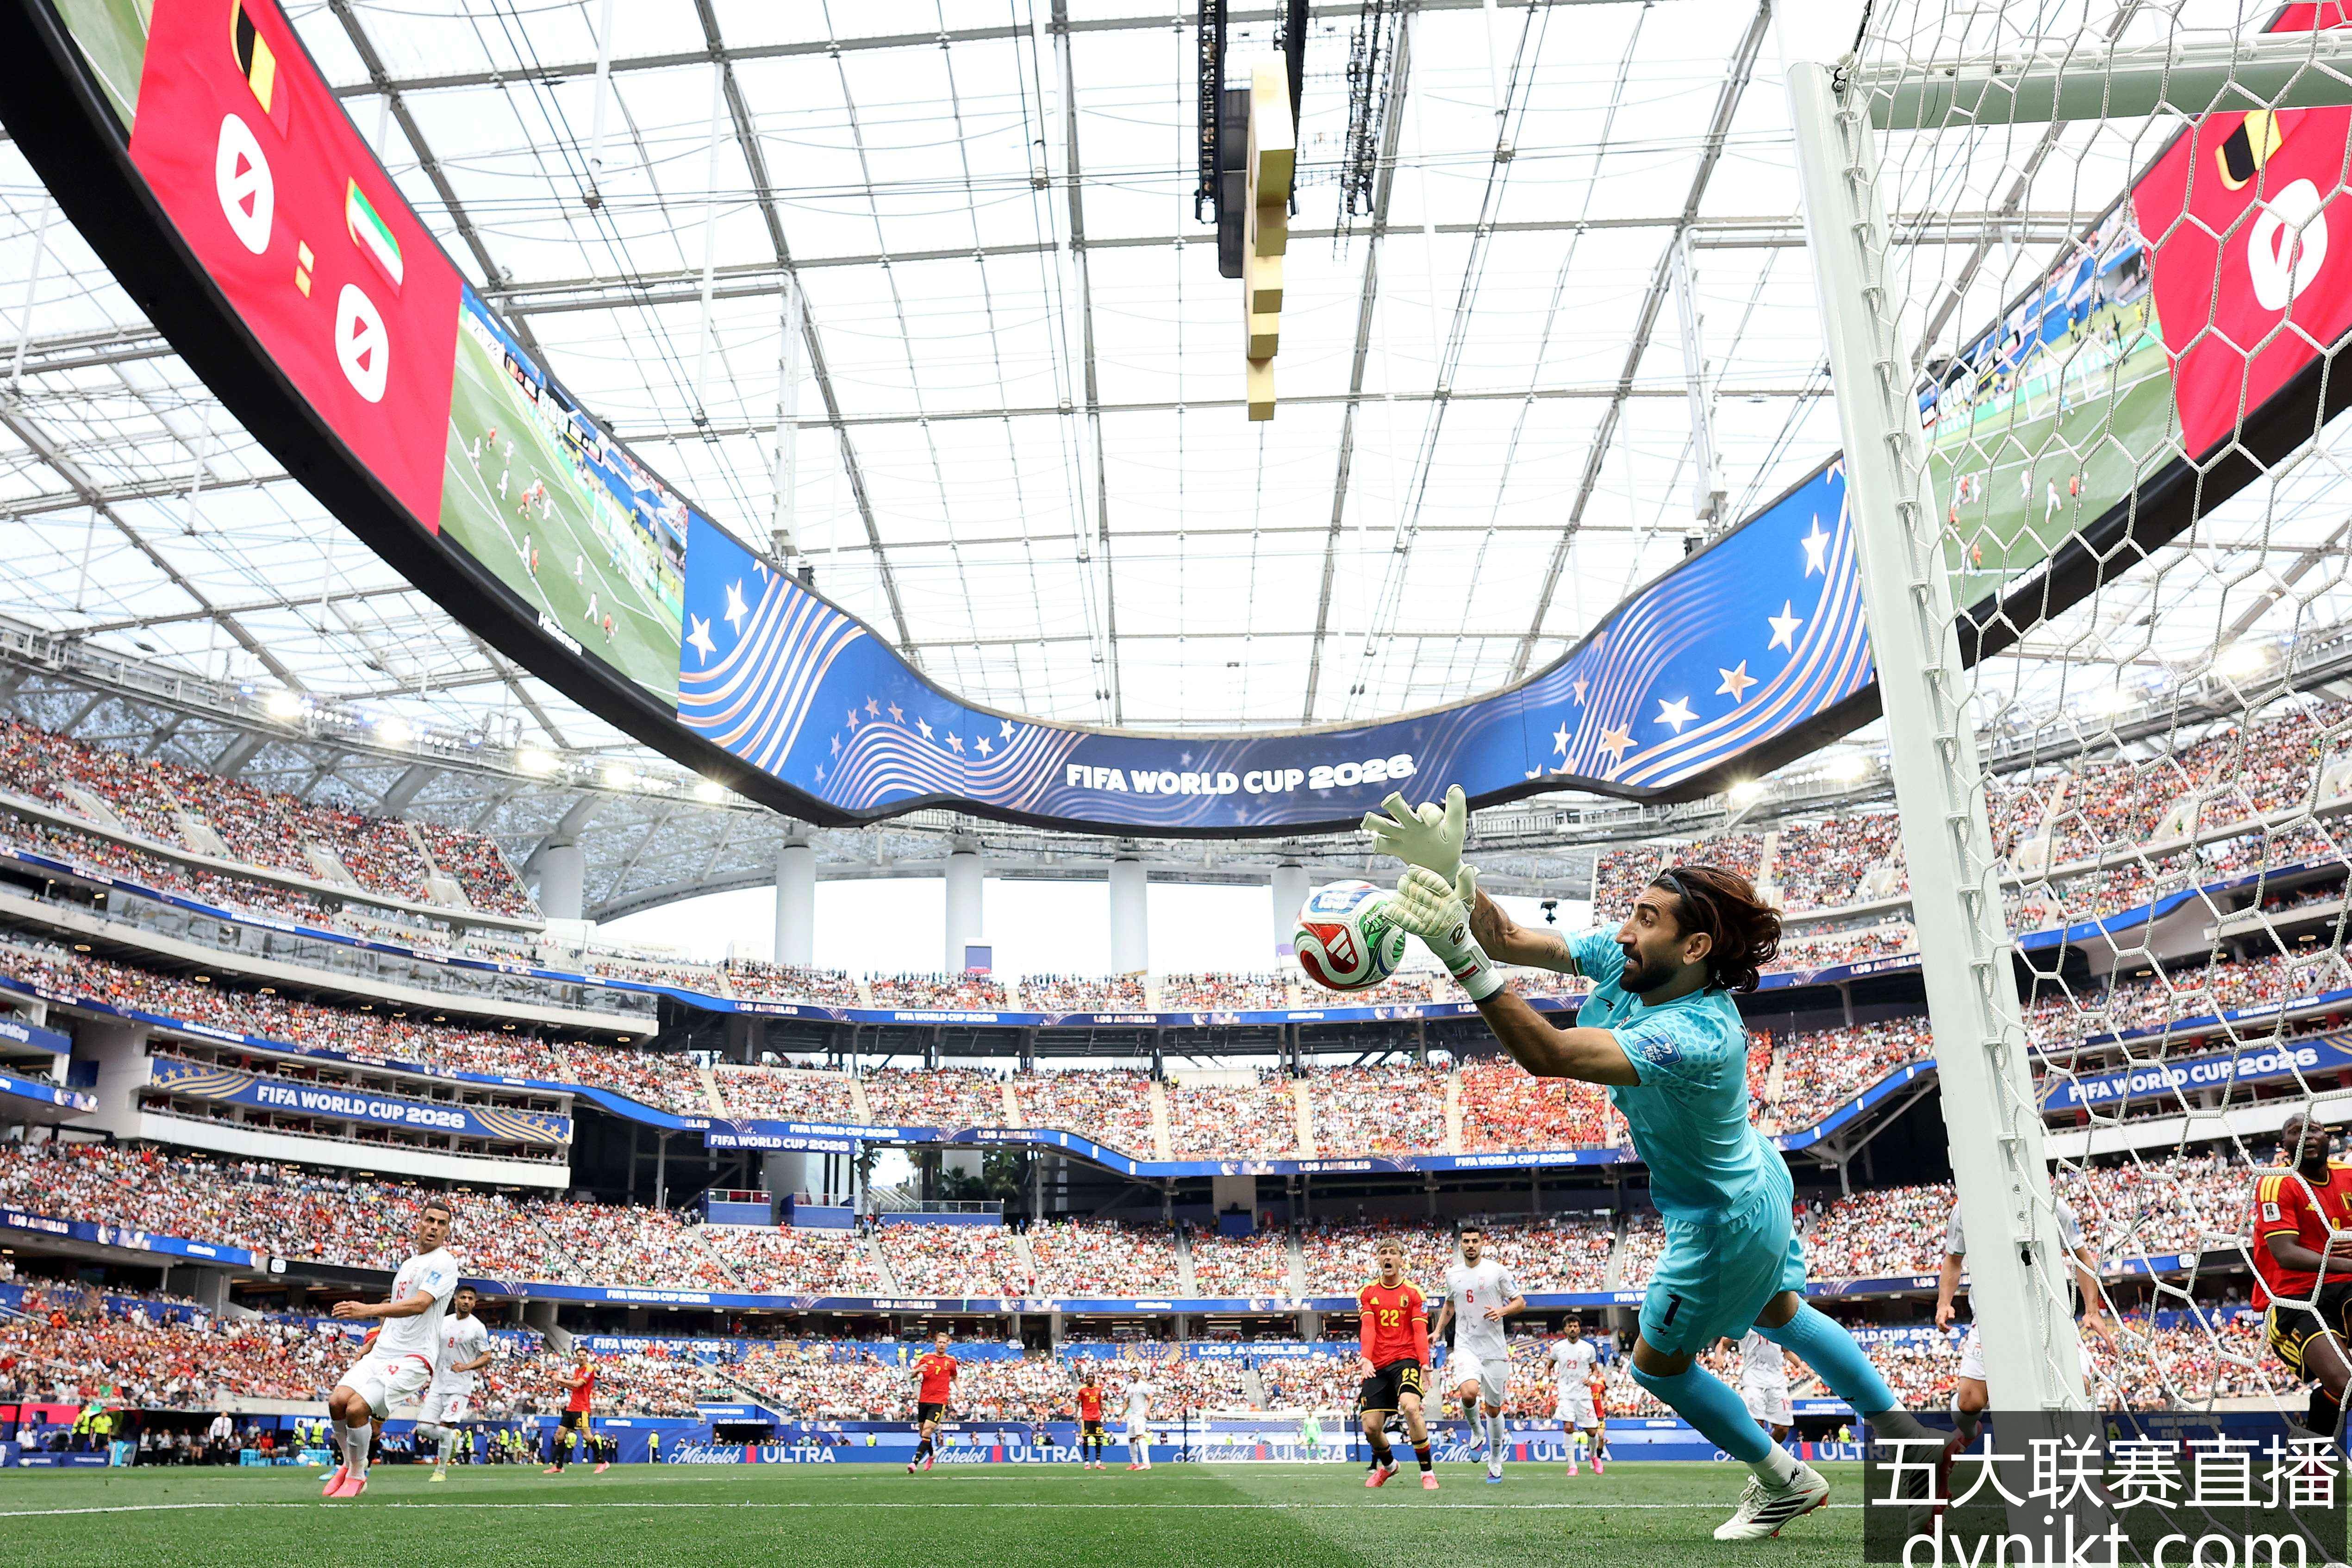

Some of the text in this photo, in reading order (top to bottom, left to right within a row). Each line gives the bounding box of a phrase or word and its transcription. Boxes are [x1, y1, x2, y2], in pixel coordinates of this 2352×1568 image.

[1066, 754, 1416, 795] FIFA WORLD CUP 2026
[2068, 1048, 2318, 1102] FIFA WORLD CUP 2026
[257, 1085, 466, 1129] FIFA WORLD CUP 2026
[711, 1134, 849, 1152] FIFA WORLD CUP 2026
[1298, 1162, 1320, 1171] LOS
[1455, 1157, 1479, 1167] FIFA
[1478, 1156, 1516, 1166] WORLD
[1517, 1154, 1539, 1164] CUP
[1466, 1290, 1473, 1303] 6
[1380, 1309, 1399, 1327] 22
[1662, 1294, 1683, 1327] 1
[593, 1337, 620, 1349] FIFA
[1879, 1330, 1908, 1342] CUP
[1199, 1345, 1310, 1355] LOS ANGELES
[935, 1365, 941, 1375] 7
[1402, 1368, 1419, 1383] 22
[452, 1402, 458, 1412] 8
[934, 1412, 940, 1422] 7
[668, 1445, 836, 1464] Michelob ULTRA
[1009, 1445, 1083, 1463] ULTRA
[1818, 1442, 1891, 1462] ULTR
